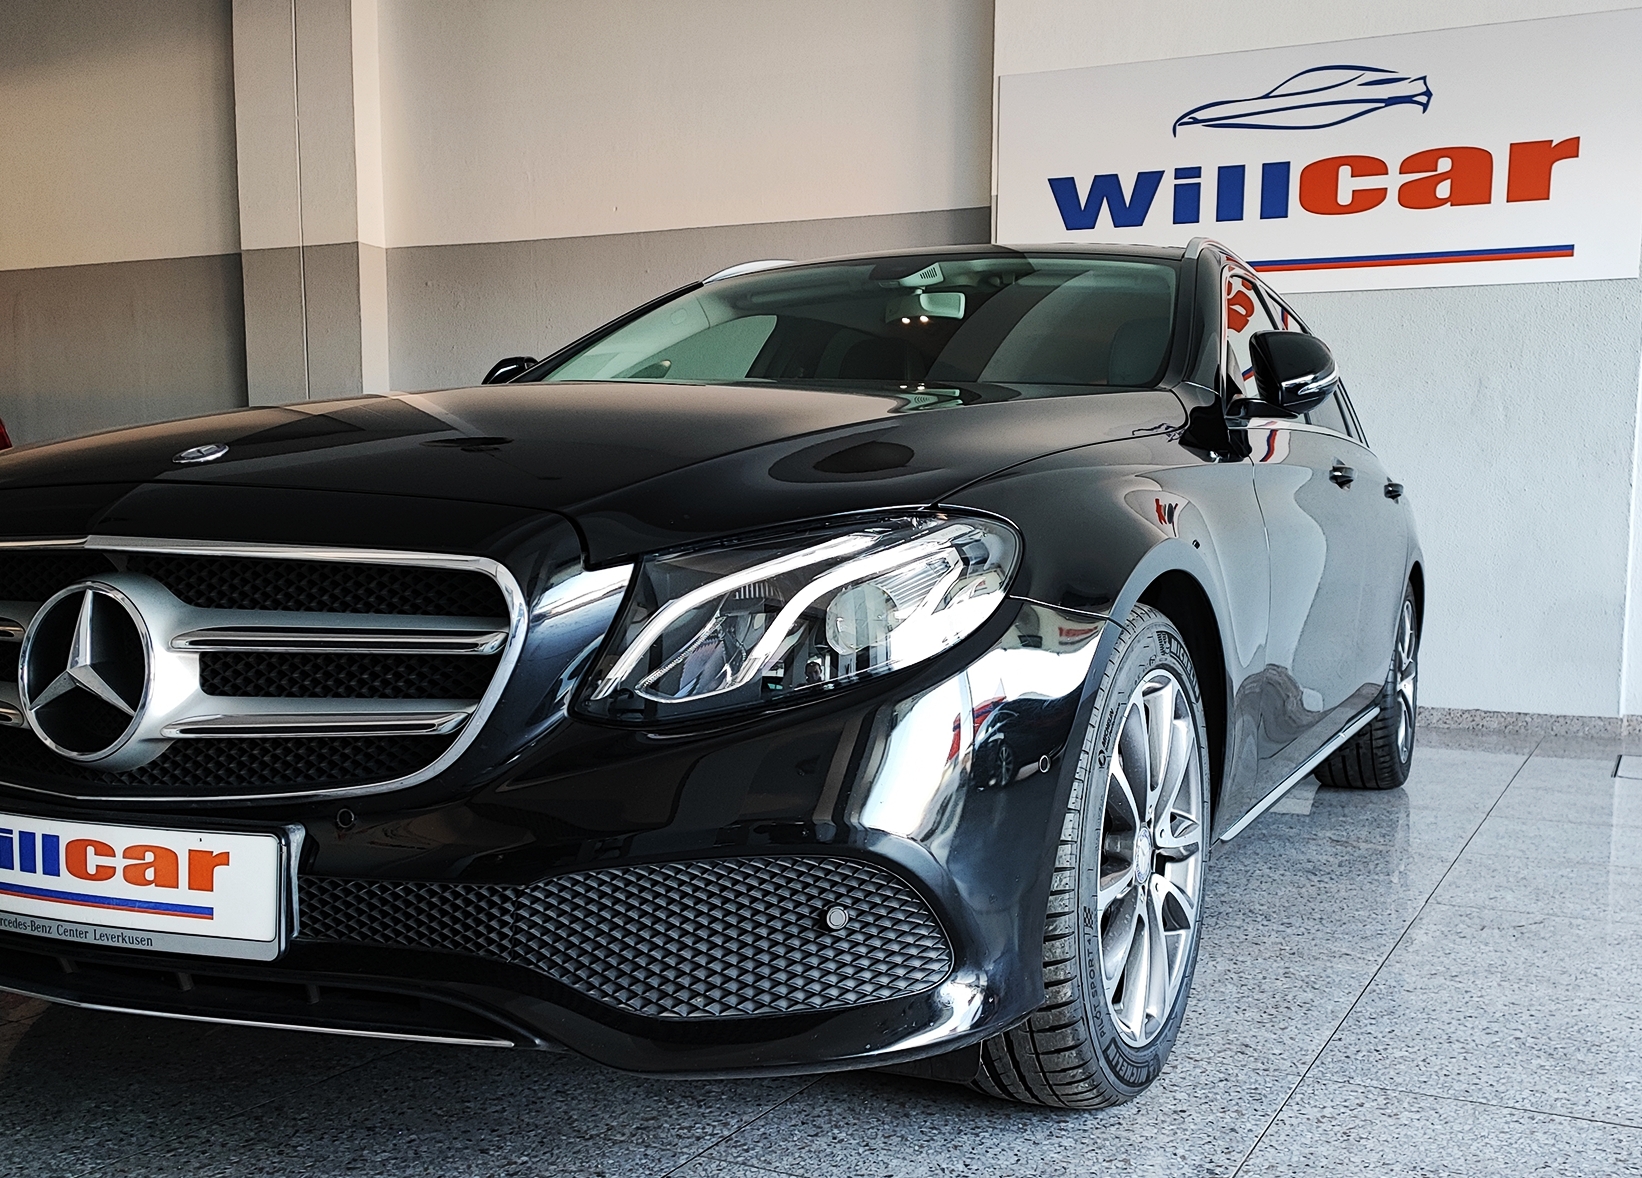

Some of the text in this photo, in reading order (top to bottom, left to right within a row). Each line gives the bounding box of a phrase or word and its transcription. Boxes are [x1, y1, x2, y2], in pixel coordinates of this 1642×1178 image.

[1047, 136, 1581, 231] willcar
[56, 924, 89, 940] Center
[93, 929, 154, 947] Leverkusen
[1087, 948, 1098, 999] SPORT
[1093, 1004, 1107, 1039] PILOT
[1106, 1042, 1149, 1084] MICHELIN
